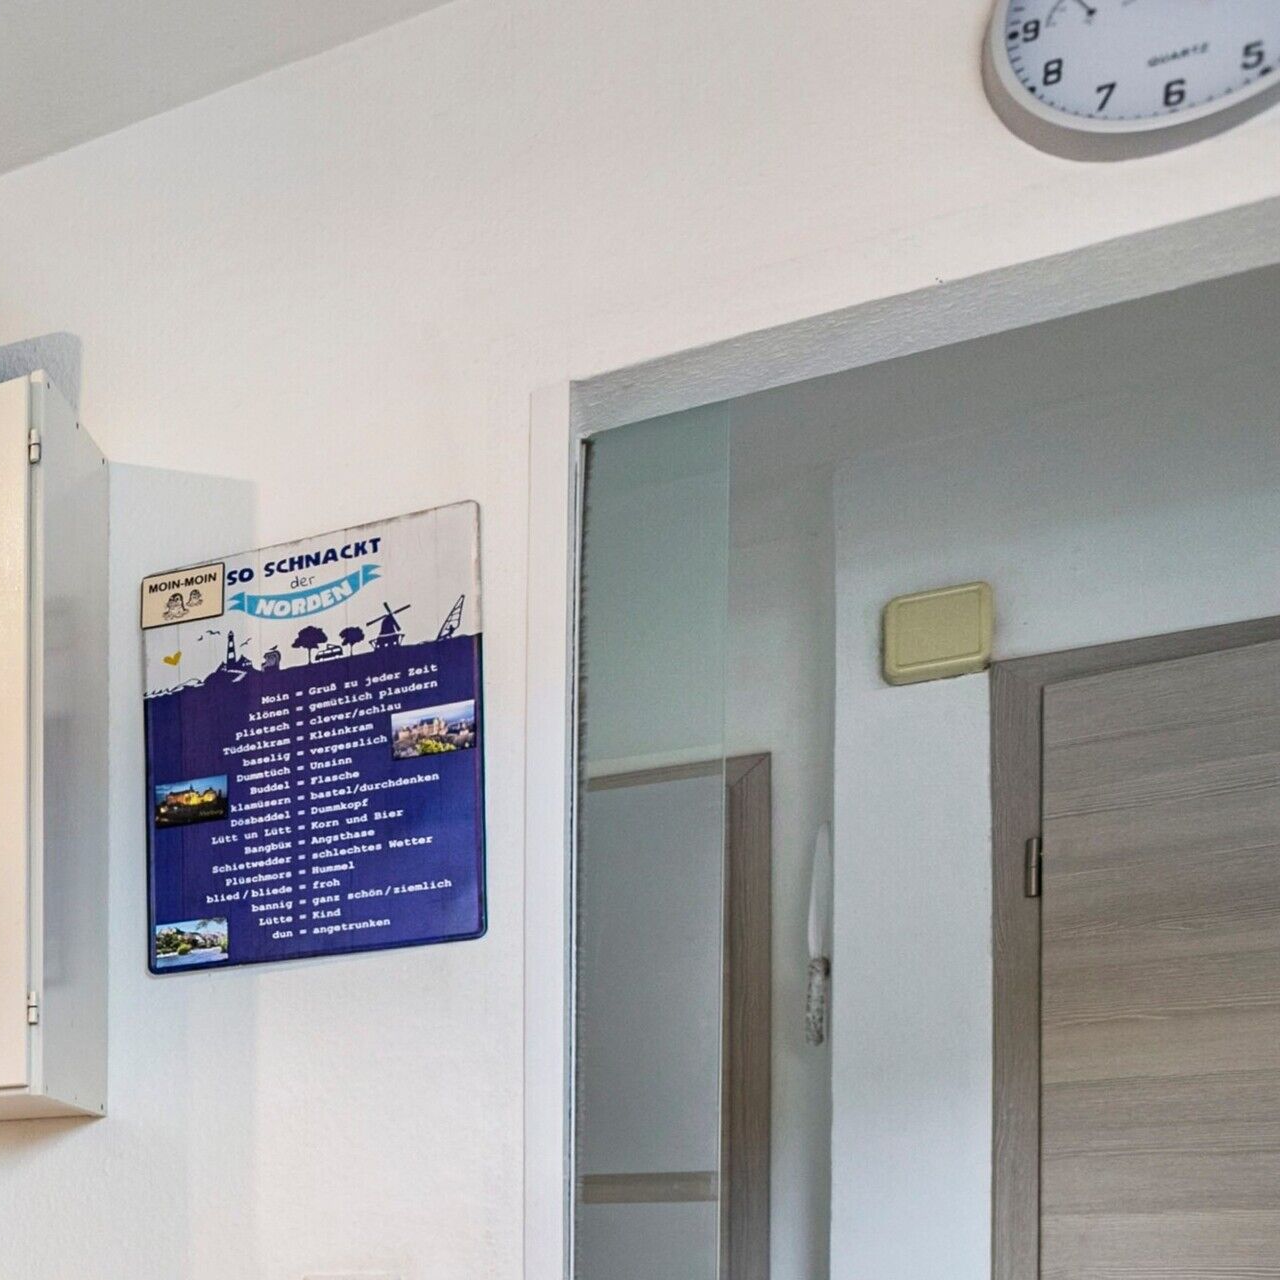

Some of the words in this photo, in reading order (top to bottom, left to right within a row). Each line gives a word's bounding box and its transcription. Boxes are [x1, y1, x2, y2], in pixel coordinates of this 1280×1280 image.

[1022, 19, 1040, 42] 9
[1242, 40, 1265, 70] 5
[1043, 58, 1063, 86] 8
[1096, 82, 1117, 112] 7
[1163, 79, 1186, 107] 6
[227, 568, 254, 586] SO
[264, 537, 381, 577] SCHNACKT
[148, 573, 217, 594] MOIN-MOIN
[290, 574, 316, 590] der
[255, 579, 353, 617] NORDEN
[260, 693, 290, 705] Moin
[308, 682, 337, 696] Gruß
[343, 679, 359, 689] zu
[364, 671, 401, 687] jeder
[407, 663, 438, 677] Zeit
[248, 708, 290, 722] klönen
[308, 691, 373, 713] gemütlich
[378, 680, 438, 700] plaudern
[222, 737, 291, 756] Tüddelkram
[309, 722, 374, 741] Kleinkram
[234, 721, 290, 741] plietsch
[242, 752, 291, 767] baselig
[309, 734, 388, 755] vergesslich
[236, 766, 291, 783] Dummtüch
[309, 756, 353, 770] Unsinn
[249, 780, 291, 795] Buddel
[310, 770, 360, 785] Flasche
[310, 797, 369, 815] Dummkopf
[210, 833, 238, 845] Lütt
[243, 831, 258, 840] un
[263, 825, 292, 837] Lütt
[310, 819, 340, 830] Korn
[345, 812, 368, 825] und
[373, 809, 404, 821] Bier
[211, 856, 292, 874] Schietwedder
[311, 843, 382, 860] schlechtes
[388, 835, 433, 848] Wetter
[243, 841, 292, 855] Bangbüx
[310, 829, 375, 845] Angsthase
[311, 860, 355, 875] Hummel
[312, 877, 341, 890] froh
[250, 899, 293, 913] bannig
[311, 894, 340, 907] ganz
[258, 915, 293, 926] Lütte
[312, 907, 341, 920] Kind
[271, 930, 294, 939] dun
[312, 918, 391, 935] angetrunken
